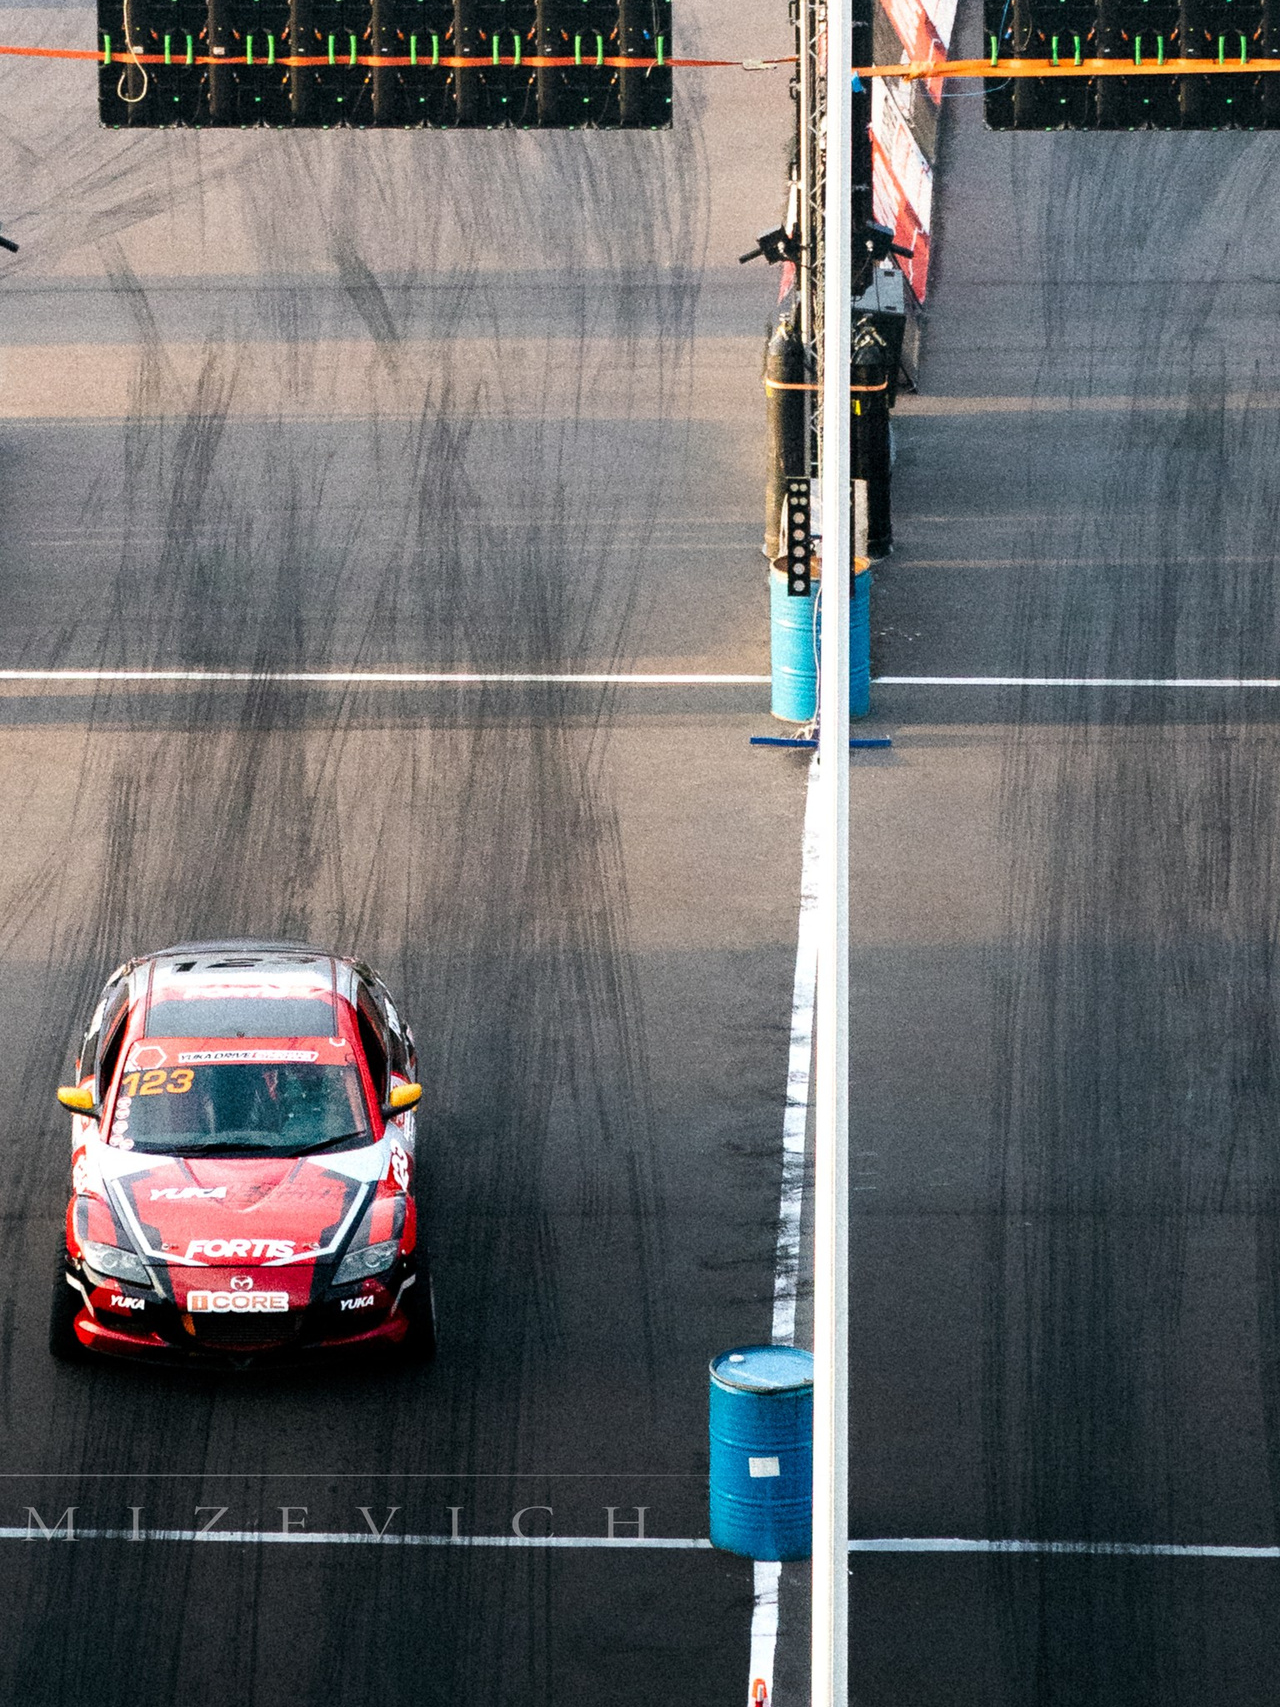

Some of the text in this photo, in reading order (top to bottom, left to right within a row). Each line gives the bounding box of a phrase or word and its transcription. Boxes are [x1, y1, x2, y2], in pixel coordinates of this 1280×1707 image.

[122, 1069, 196, 1097] 123
[184, 1239, 296, 1261] FORTIS
[110, 1295, 146, 1311] YUKA
[340, 1295, 375, 1311] YUKA
